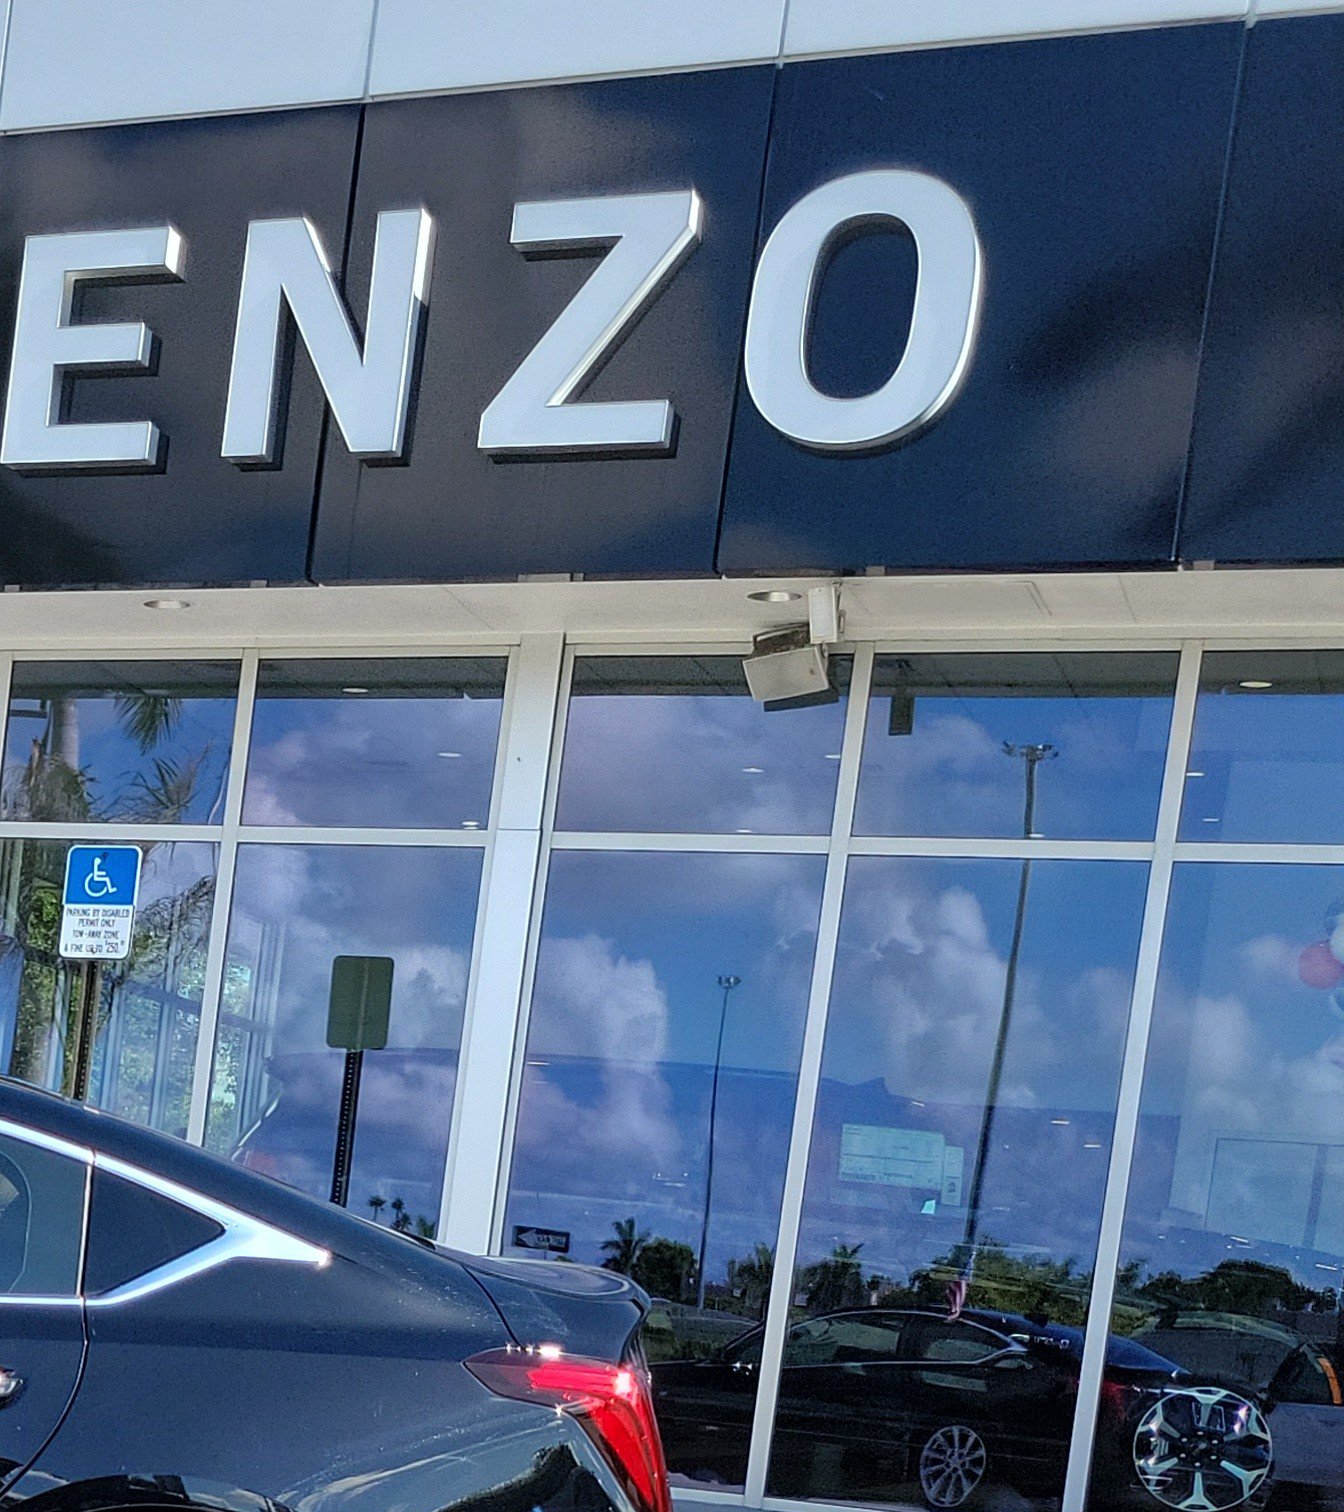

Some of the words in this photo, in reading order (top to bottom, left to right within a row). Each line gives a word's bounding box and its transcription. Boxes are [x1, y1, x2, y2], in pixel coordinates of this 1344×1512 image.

[78, 918, 99, 928] PERMIT
[100, 919, 116, 928] ONLY
[103, 931, 119, 940] ZONE
